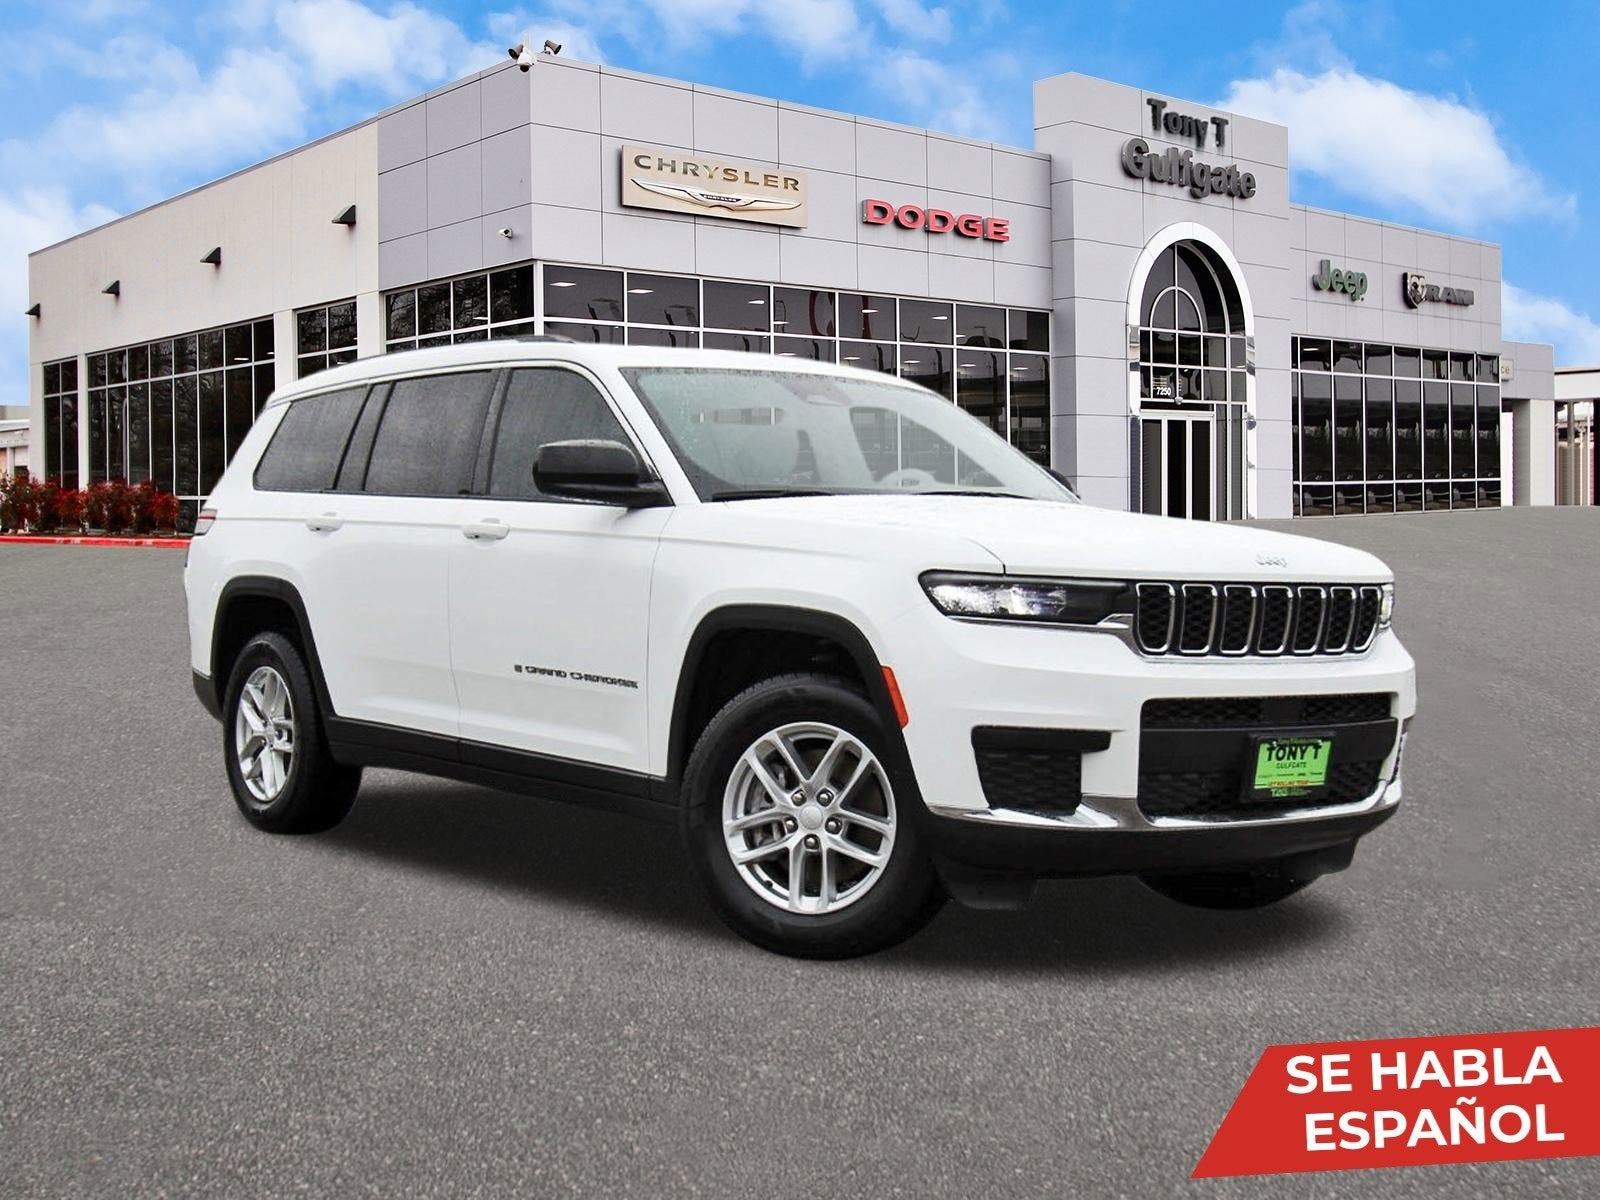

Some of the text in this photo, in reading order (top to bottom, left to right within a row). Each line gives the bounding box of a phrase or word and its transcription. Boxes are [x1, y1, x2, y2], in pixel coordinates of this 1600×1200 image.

[1146, 97, 1229, 148] Tony T
[633, 154, 800, 192] CHRYSLER
[1121, 137, 1256, 199] Gulfgate
[863, 199, 1010, 242] DODGE
[1312, 259, 1367, 302] Jeep
[1424, 284, 1474, 306] RAM
[1266, 743, 1322, 761] TONY T
